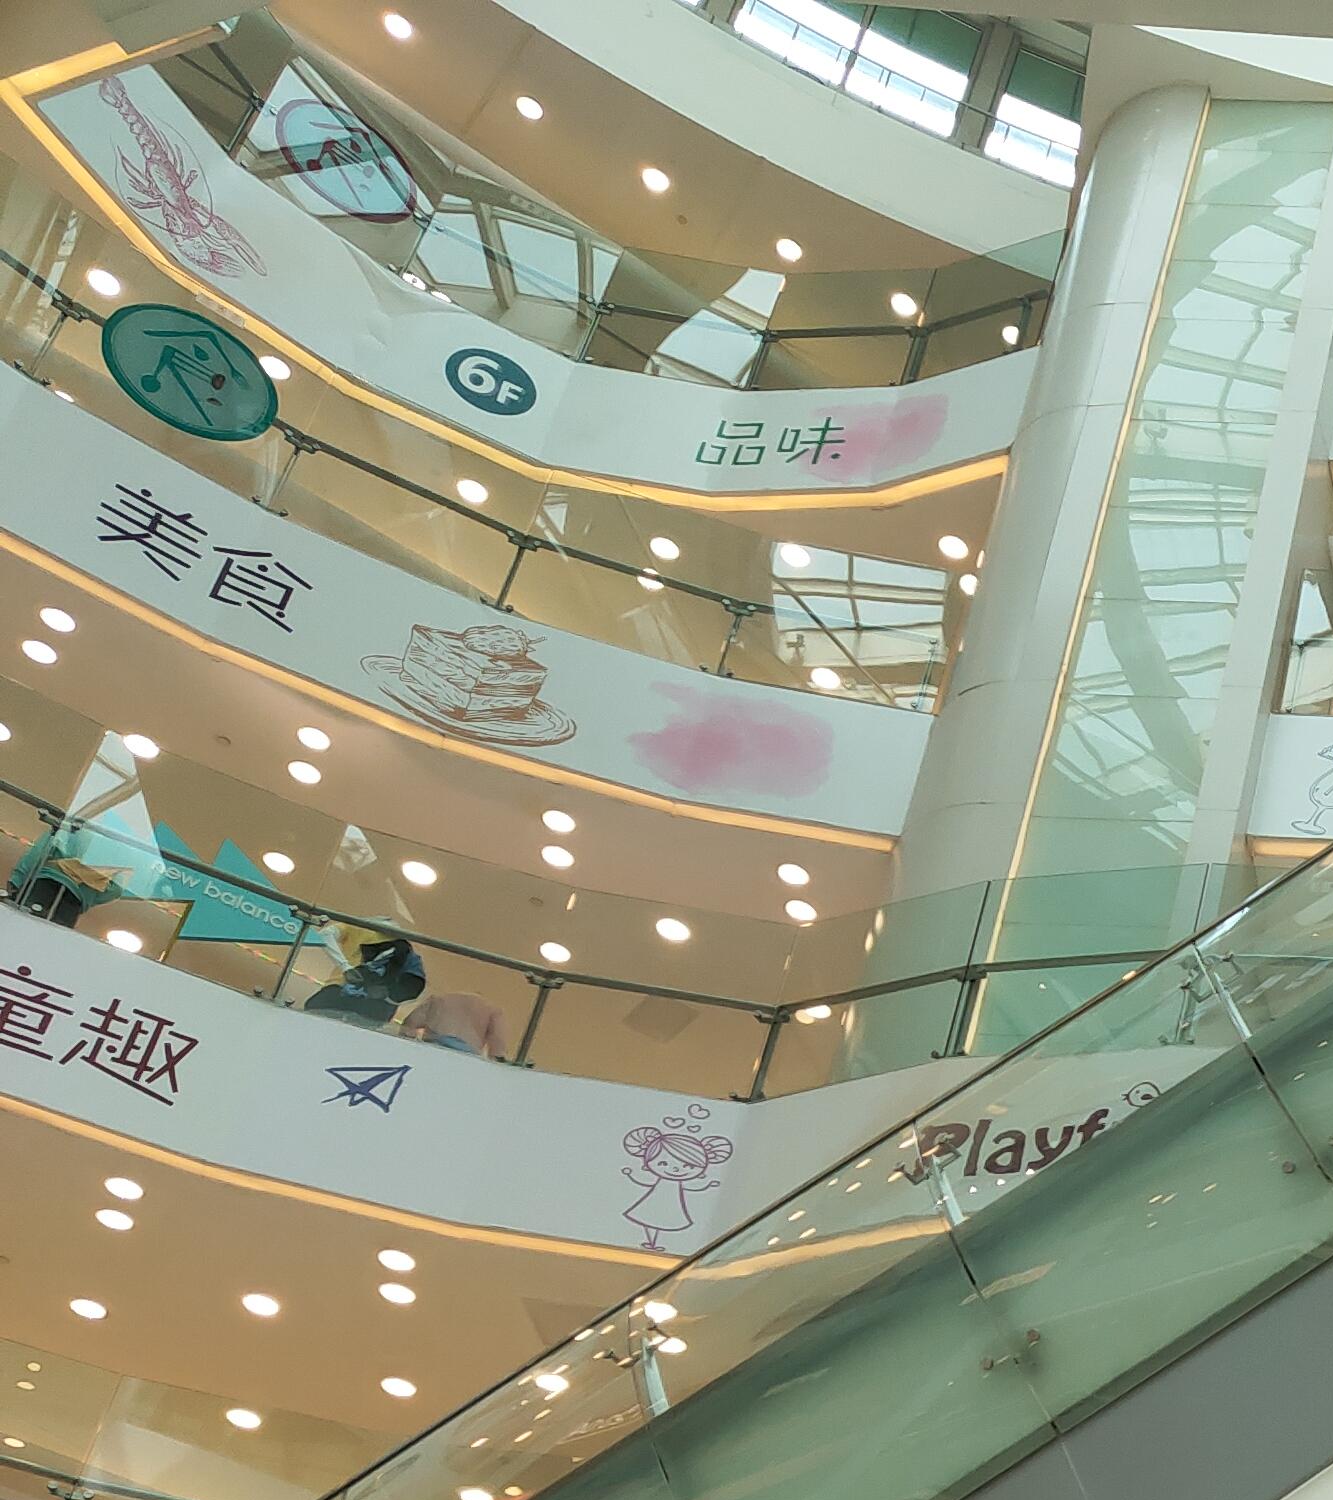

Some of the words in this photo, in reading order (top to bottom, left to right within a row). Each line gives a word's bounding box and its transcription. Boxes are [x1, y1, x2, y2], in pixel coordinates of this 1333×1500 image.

[457, 355, 524, 405] 6F
[695, 415, 847, 465] 品味
[96, 483, 313, 633] 美食
[152, 860, 200, 889] new
[203, 880, 300, 935] balance
